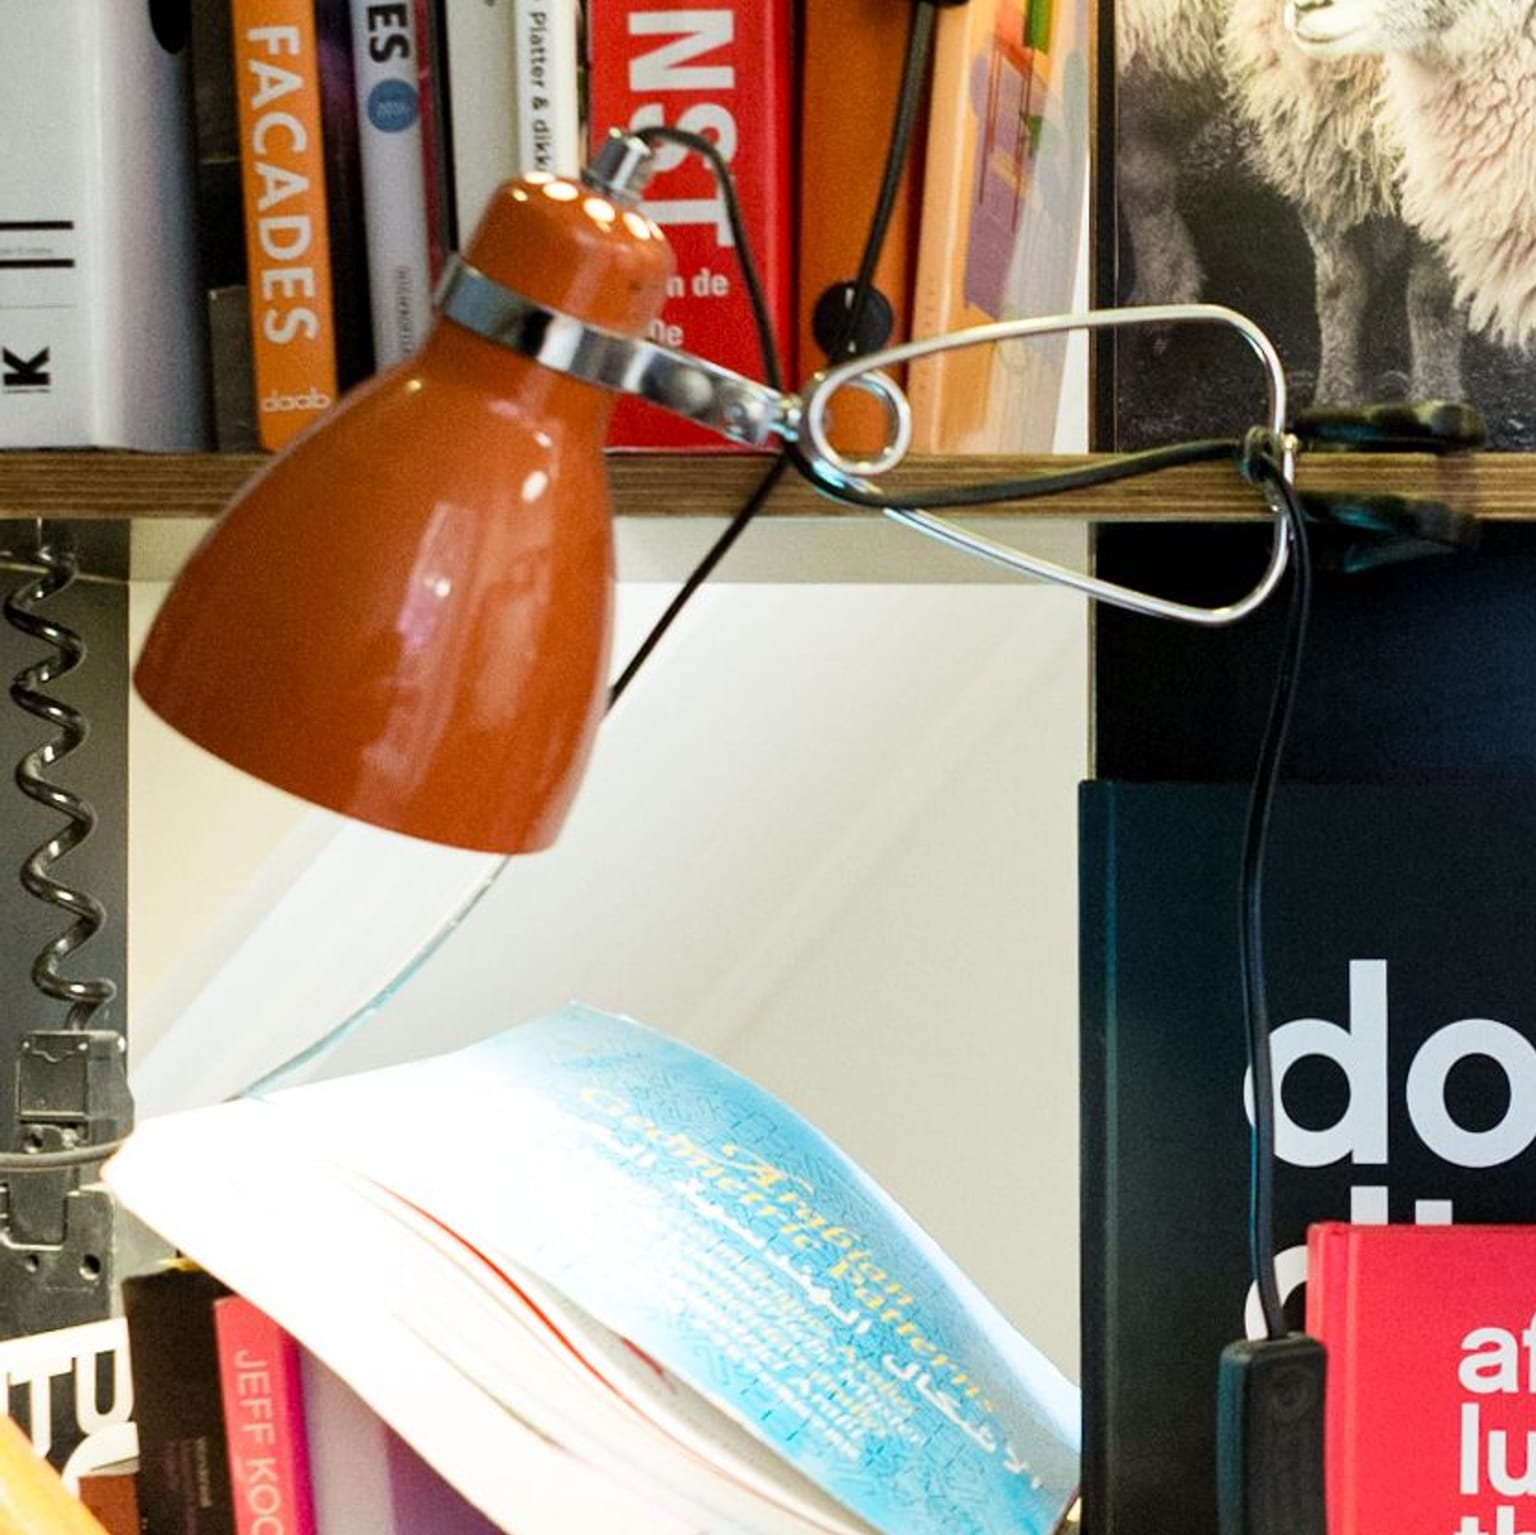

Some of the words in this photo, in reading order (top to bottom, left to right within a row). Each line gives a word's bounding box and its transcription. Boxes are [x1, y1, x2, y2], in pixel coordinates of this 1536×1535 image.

[530, 11, 548, 87] Platter
[532, 94, 548, 112] &
[532, 118, 551, 172] dikk
[246, 24, 320, 346] FACADES
[829, 1256, 1000, 1416] Patterns
[234, 1348, 274, 1446] JEFF
